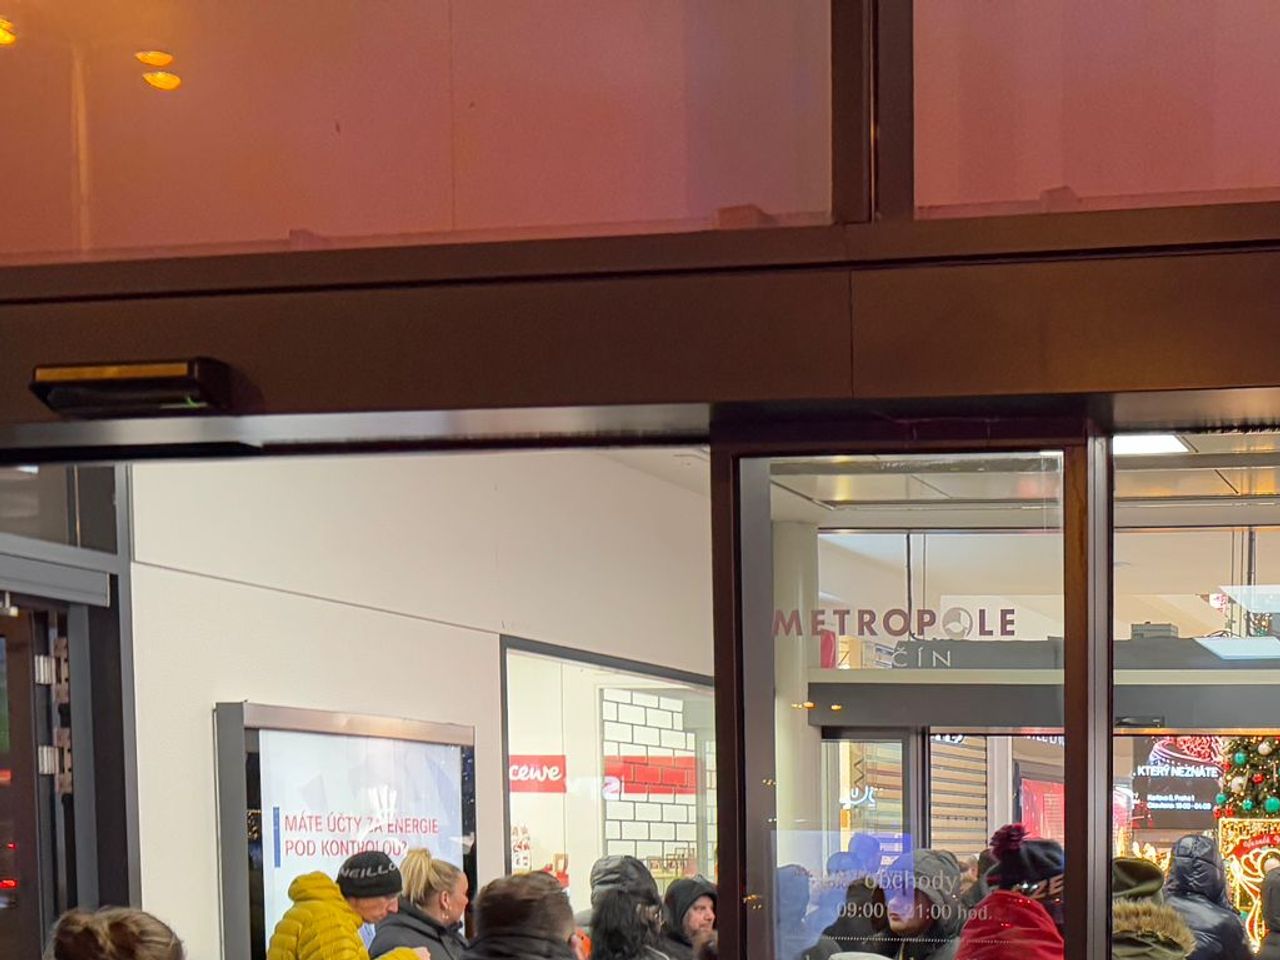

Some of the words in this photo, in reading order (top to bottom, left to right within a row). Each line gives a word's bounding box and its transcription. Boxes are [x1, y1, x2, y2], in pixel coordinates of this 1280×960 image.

[771, 607, 1016, 638] METROPOLE
[509, 764, 562, 781] cewe
[284, 811, 323, 832] MÁTE
[327, 811, 362, 833] ÚČTY
[367, 817, 384, 833] ZA
[387, 818, 439, 834] ENERGIE
[285, 841, 316, 857] POD
[321, 840, 408, 857] KONTROLOU?
[837, 902, 884, 919] 09:00
[957, 904, 993, 920] hod.
